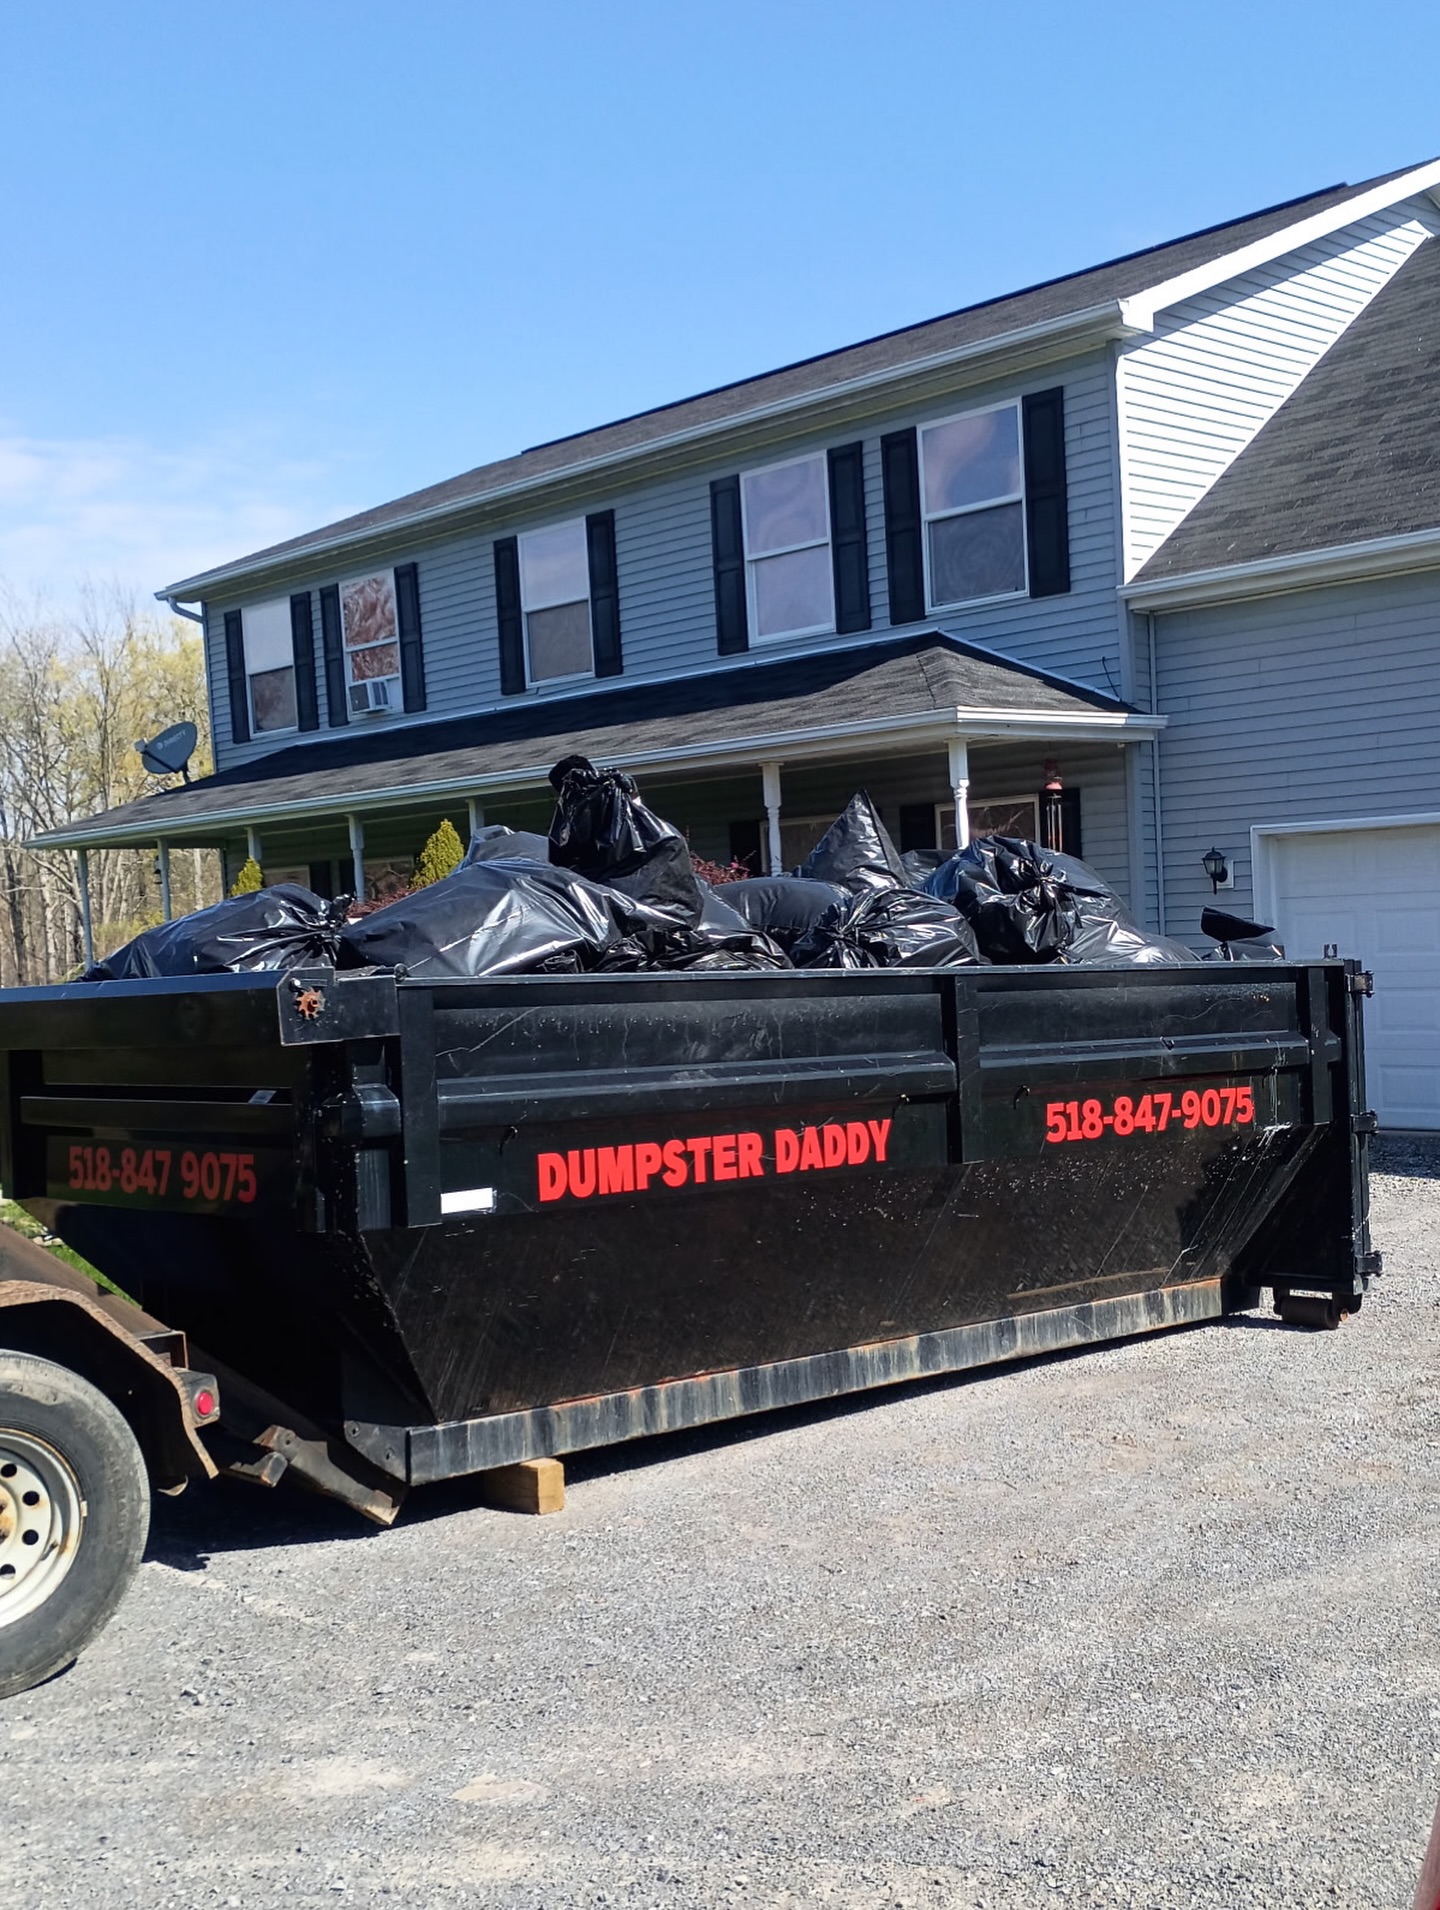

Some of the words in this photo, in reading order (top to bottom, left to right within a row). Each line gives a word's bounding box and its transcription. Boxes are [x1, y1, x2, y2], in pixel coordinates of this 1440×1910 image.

[1046, 1086, 1254, 1143] 518-847-9075
[69, 1146, 172, 1195] 518-847
[180, 1151, 257, 1203] 9075
[538, 1131, 764, 1202] DUMPSTER
[774, 1118, 891, 1174] DADDY
